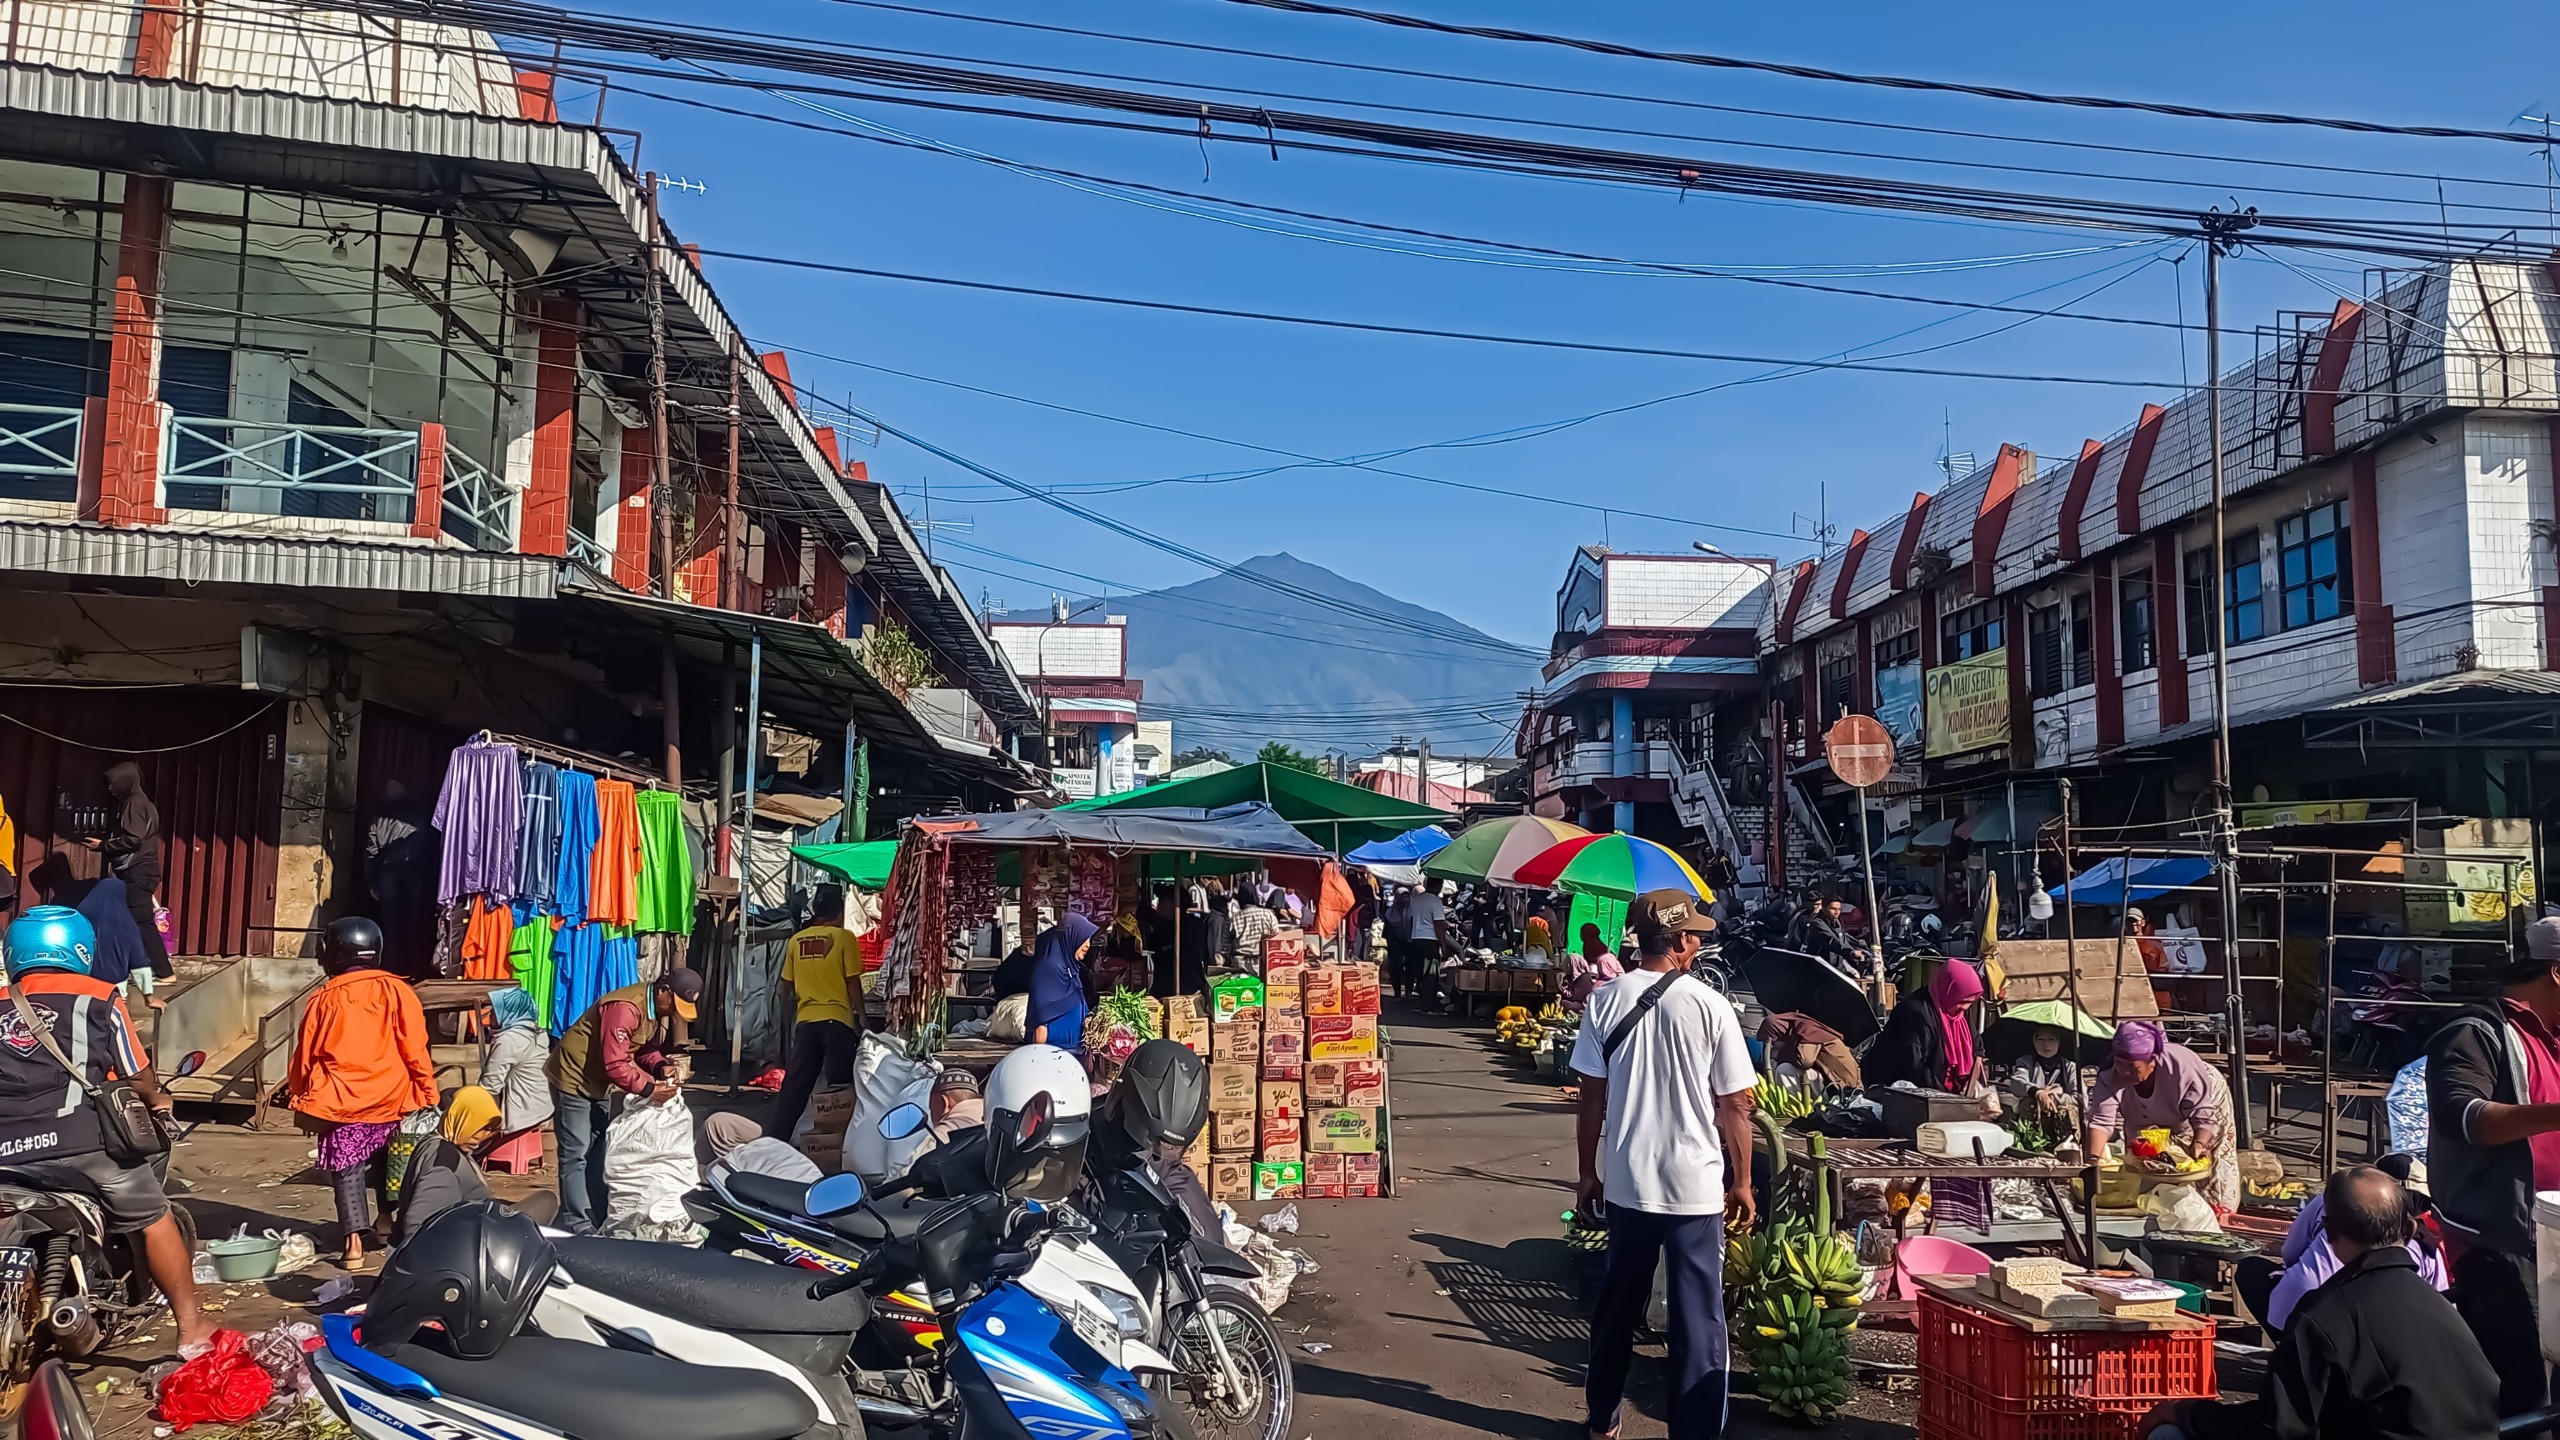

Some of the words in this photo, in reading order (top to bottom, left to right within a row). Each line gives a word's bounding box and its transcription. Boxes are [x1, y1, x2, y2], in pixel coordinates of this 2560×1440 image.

[1953, 675, 1971, 698] MAU
[1972, 668, 1996, 693] SEHAT
[1980, 690, 1997, 703] JAMU
[1947, 707, 1973, 735] KIDANG
[1973, 699, 2008, 729] KENCONO
[1291, 1067, 1301, 1076] 40
[1332, 1096, 1343, 1106] 40
[1318, 1117, 1367, 1129] Sedaap
[1163, 1129, 1186, 1141] HONDA
[1332, 1185, 1343, 1194] 40
[885, 1312, 925, 1323] ASTREA
